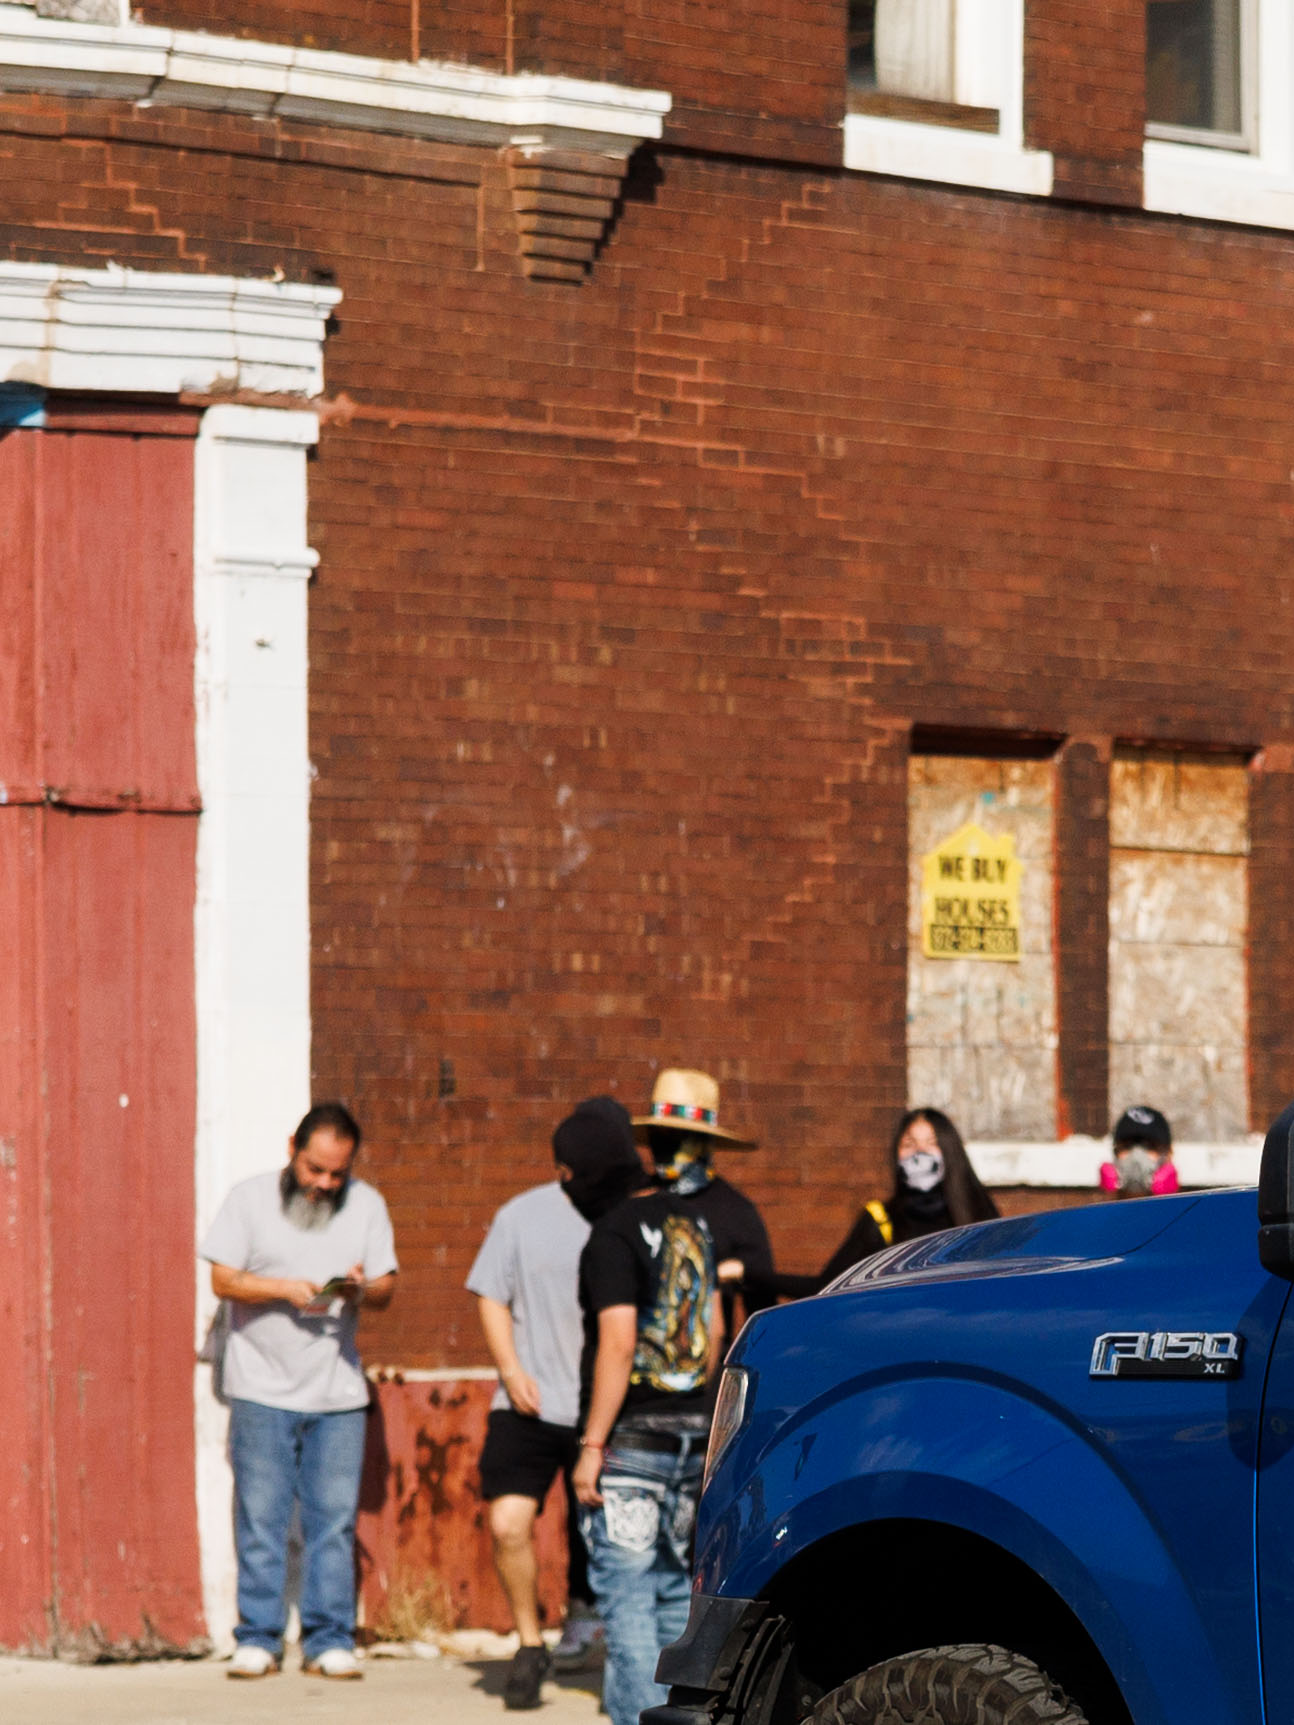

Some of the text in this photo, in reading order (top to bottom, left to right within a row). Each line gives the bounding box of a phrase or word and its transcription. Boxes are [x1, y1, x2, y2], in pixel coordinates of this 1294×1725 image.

[938, 855, 1008, 884] WE BUY
[934, 897, 1009, 925] HOUSES
[1089, 1332, 1239, 1376] F150
[1203, 1362, 1225, 1374] XL
